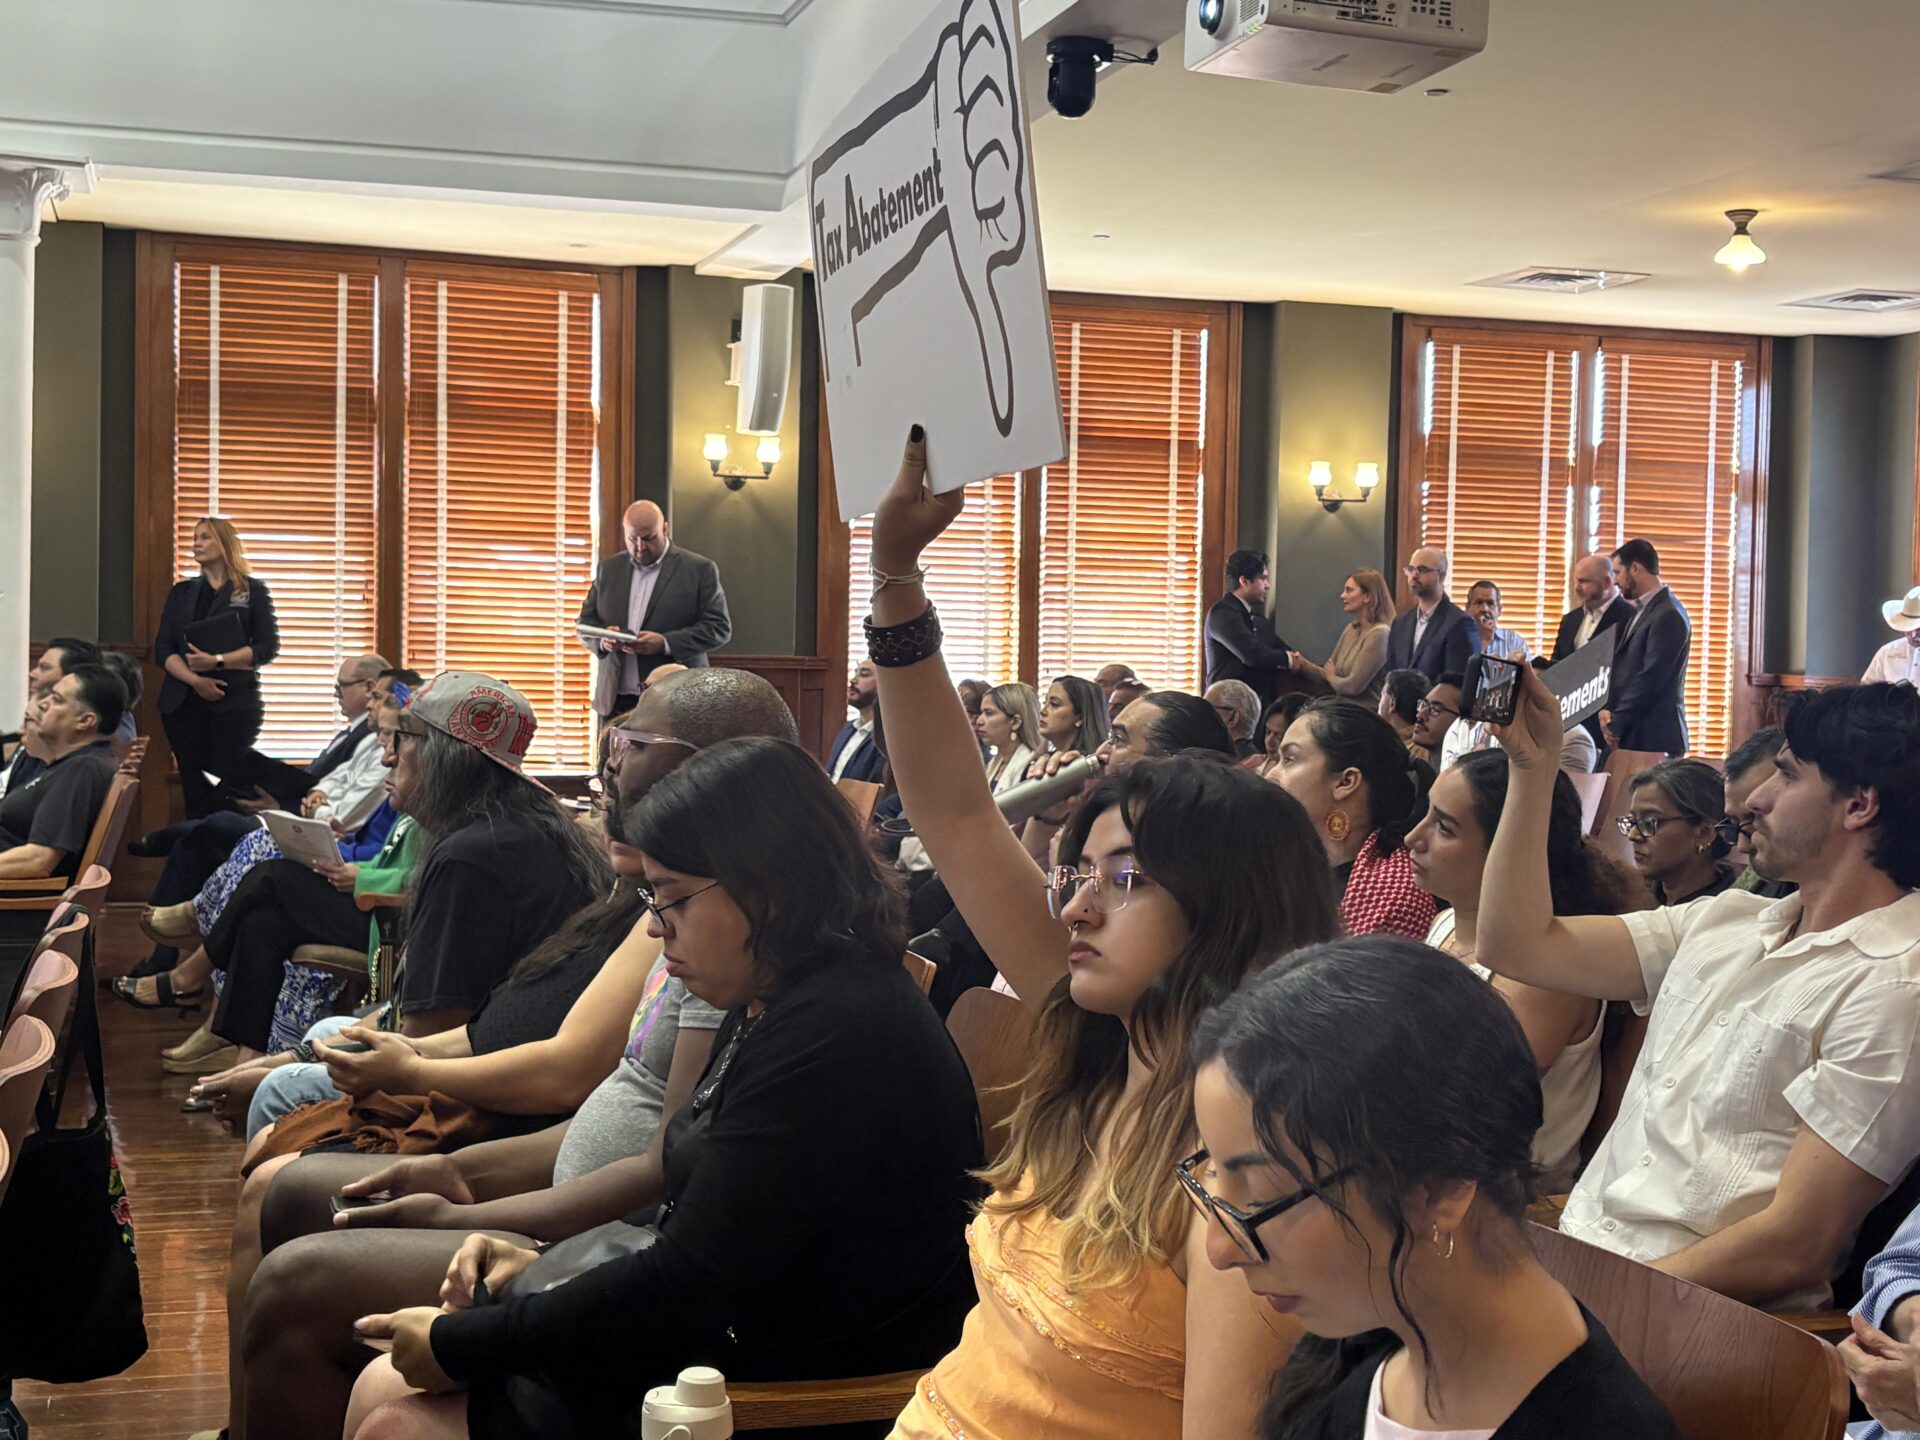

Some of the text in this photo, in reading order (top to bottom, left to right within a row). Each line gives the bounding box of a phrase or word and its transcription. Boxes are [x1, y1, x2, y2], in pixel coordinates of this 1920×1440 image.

[815, 147, 943, 282] Tax Abatement
[470, 687, 515, 718] AMERICAN
[1555, 666, 1611, 721] ements
